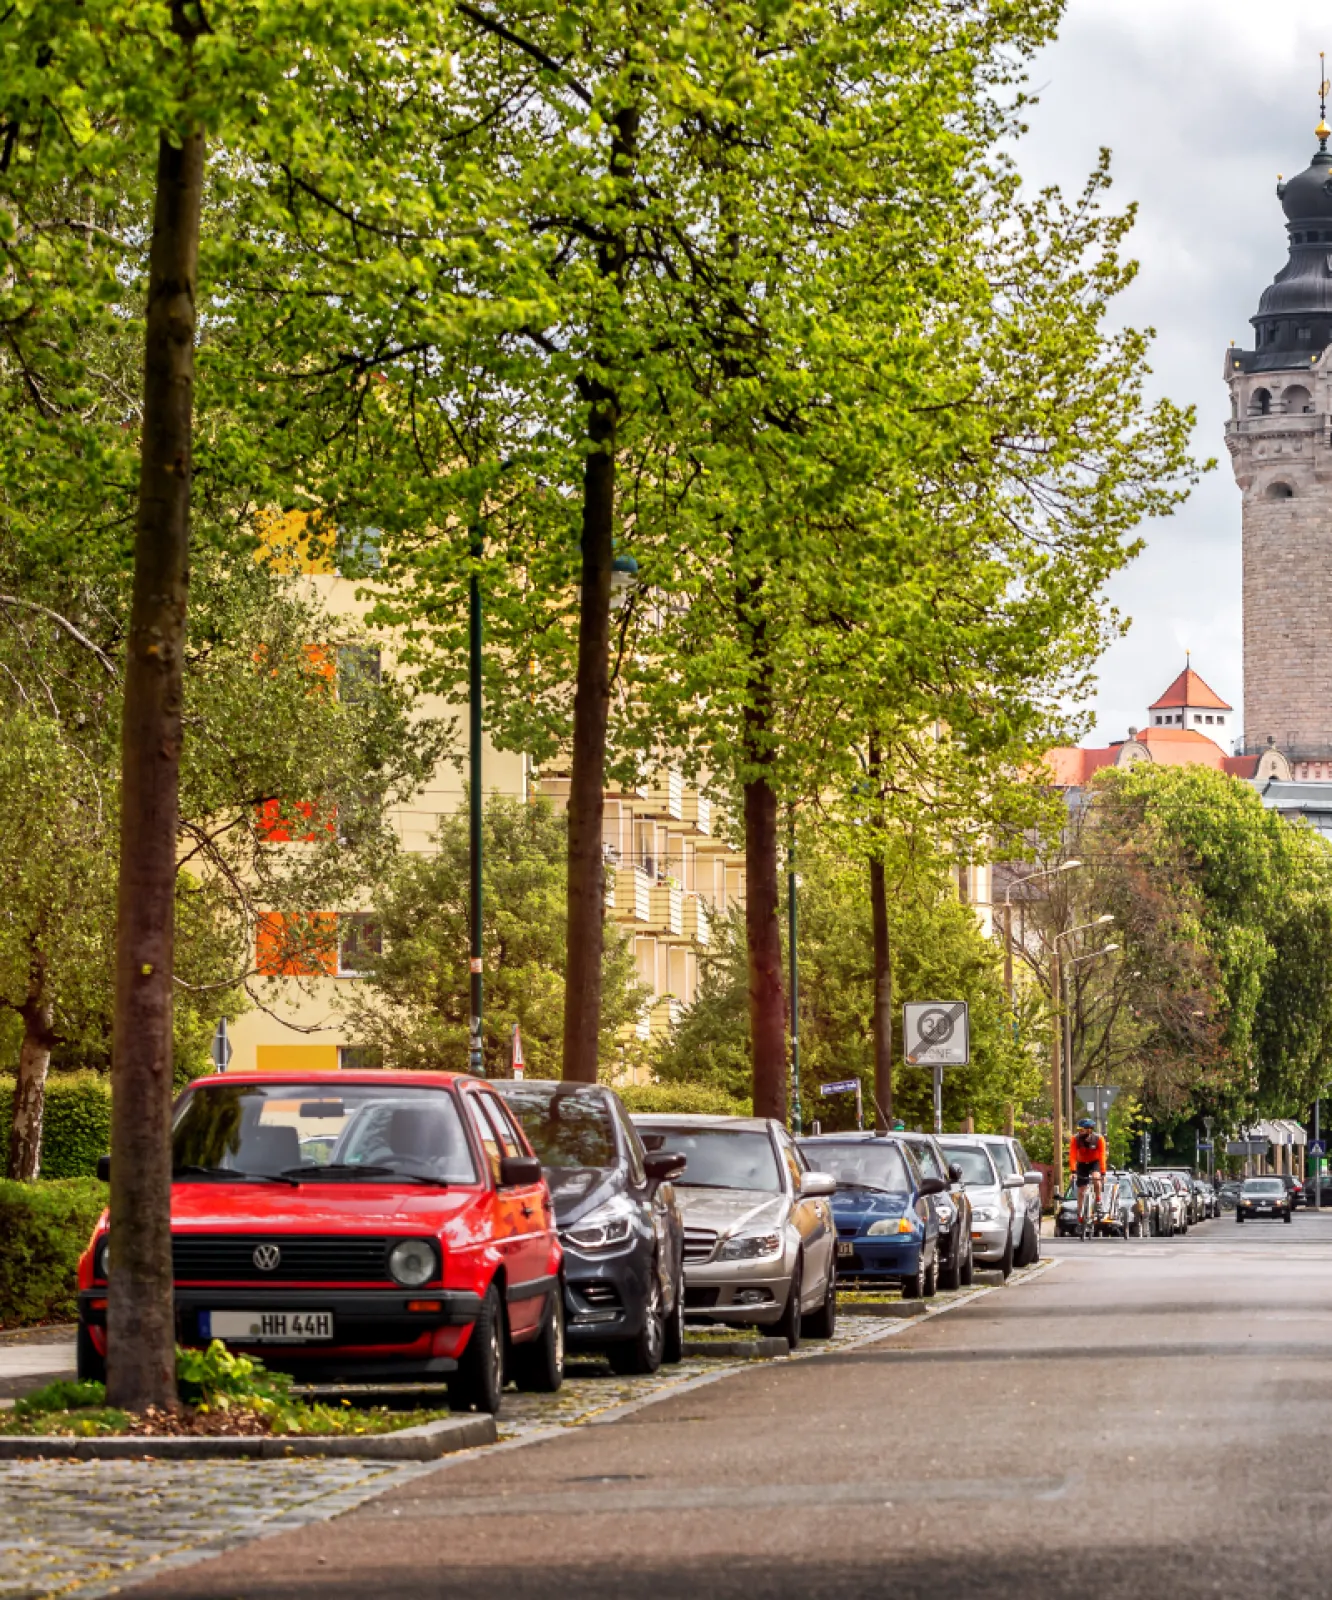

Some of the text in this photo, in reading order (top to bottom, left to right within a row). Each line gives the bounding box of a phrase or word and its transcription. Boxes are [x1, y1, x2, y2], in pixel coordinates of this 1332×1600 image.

[922, 1018, 949, 1036] 30
[261, 1315, 329, 1335] HH 44H
